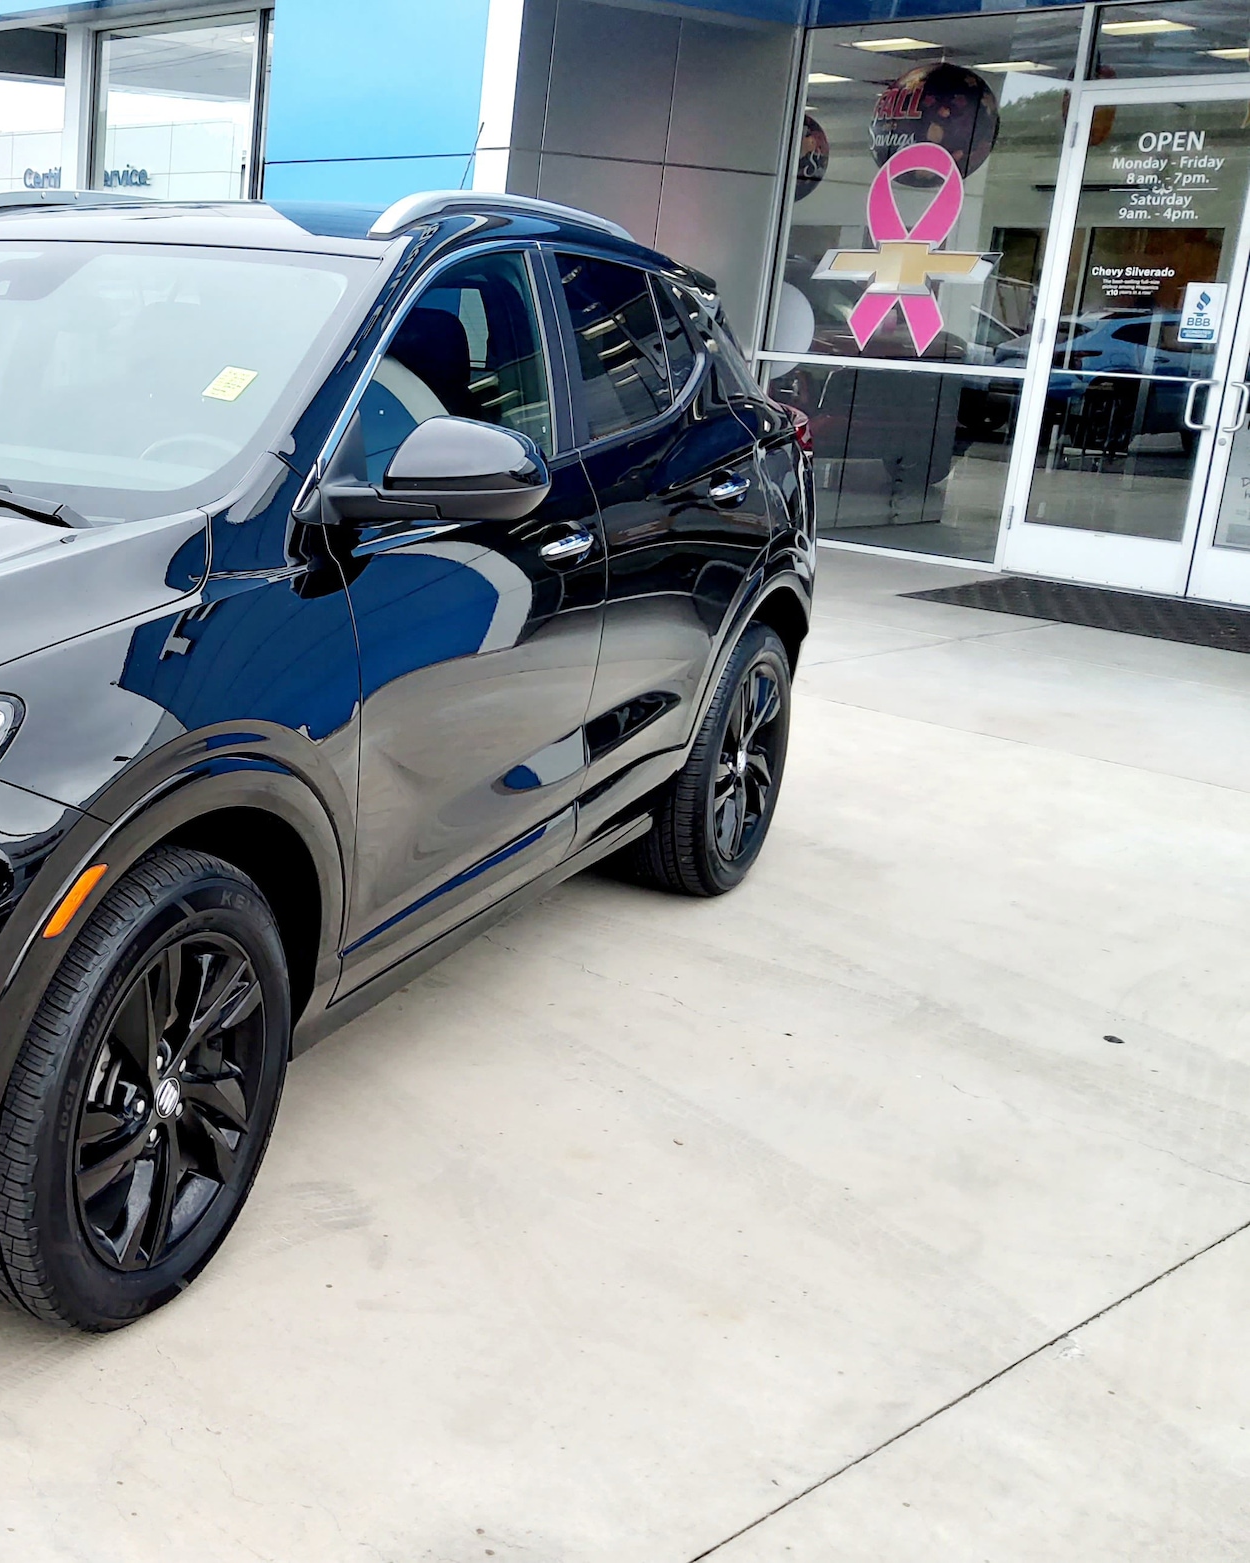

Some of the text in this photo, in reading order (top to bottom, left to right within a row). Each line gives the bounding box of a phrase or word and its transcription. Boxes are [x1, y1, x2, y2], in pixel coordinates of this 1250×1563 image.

[1138, 130, 1206, 152] OPEN
[1112, 156, 1168, 171] Monday
[1179, 155, 1225, 171] Friday
[24, 163, 151, 189] Certi ervice
[1173, 172, 1210, 186] 7pm.
[1129, 193, 1193, 208] Saturday
[1118, 207, 1152, 219] 9am.
[1163, 207, 1199, 222] 4pm.
[1091, 265, 1175, 278] Chevy Silverado
[1186, 317, 1211, 327] BBB
